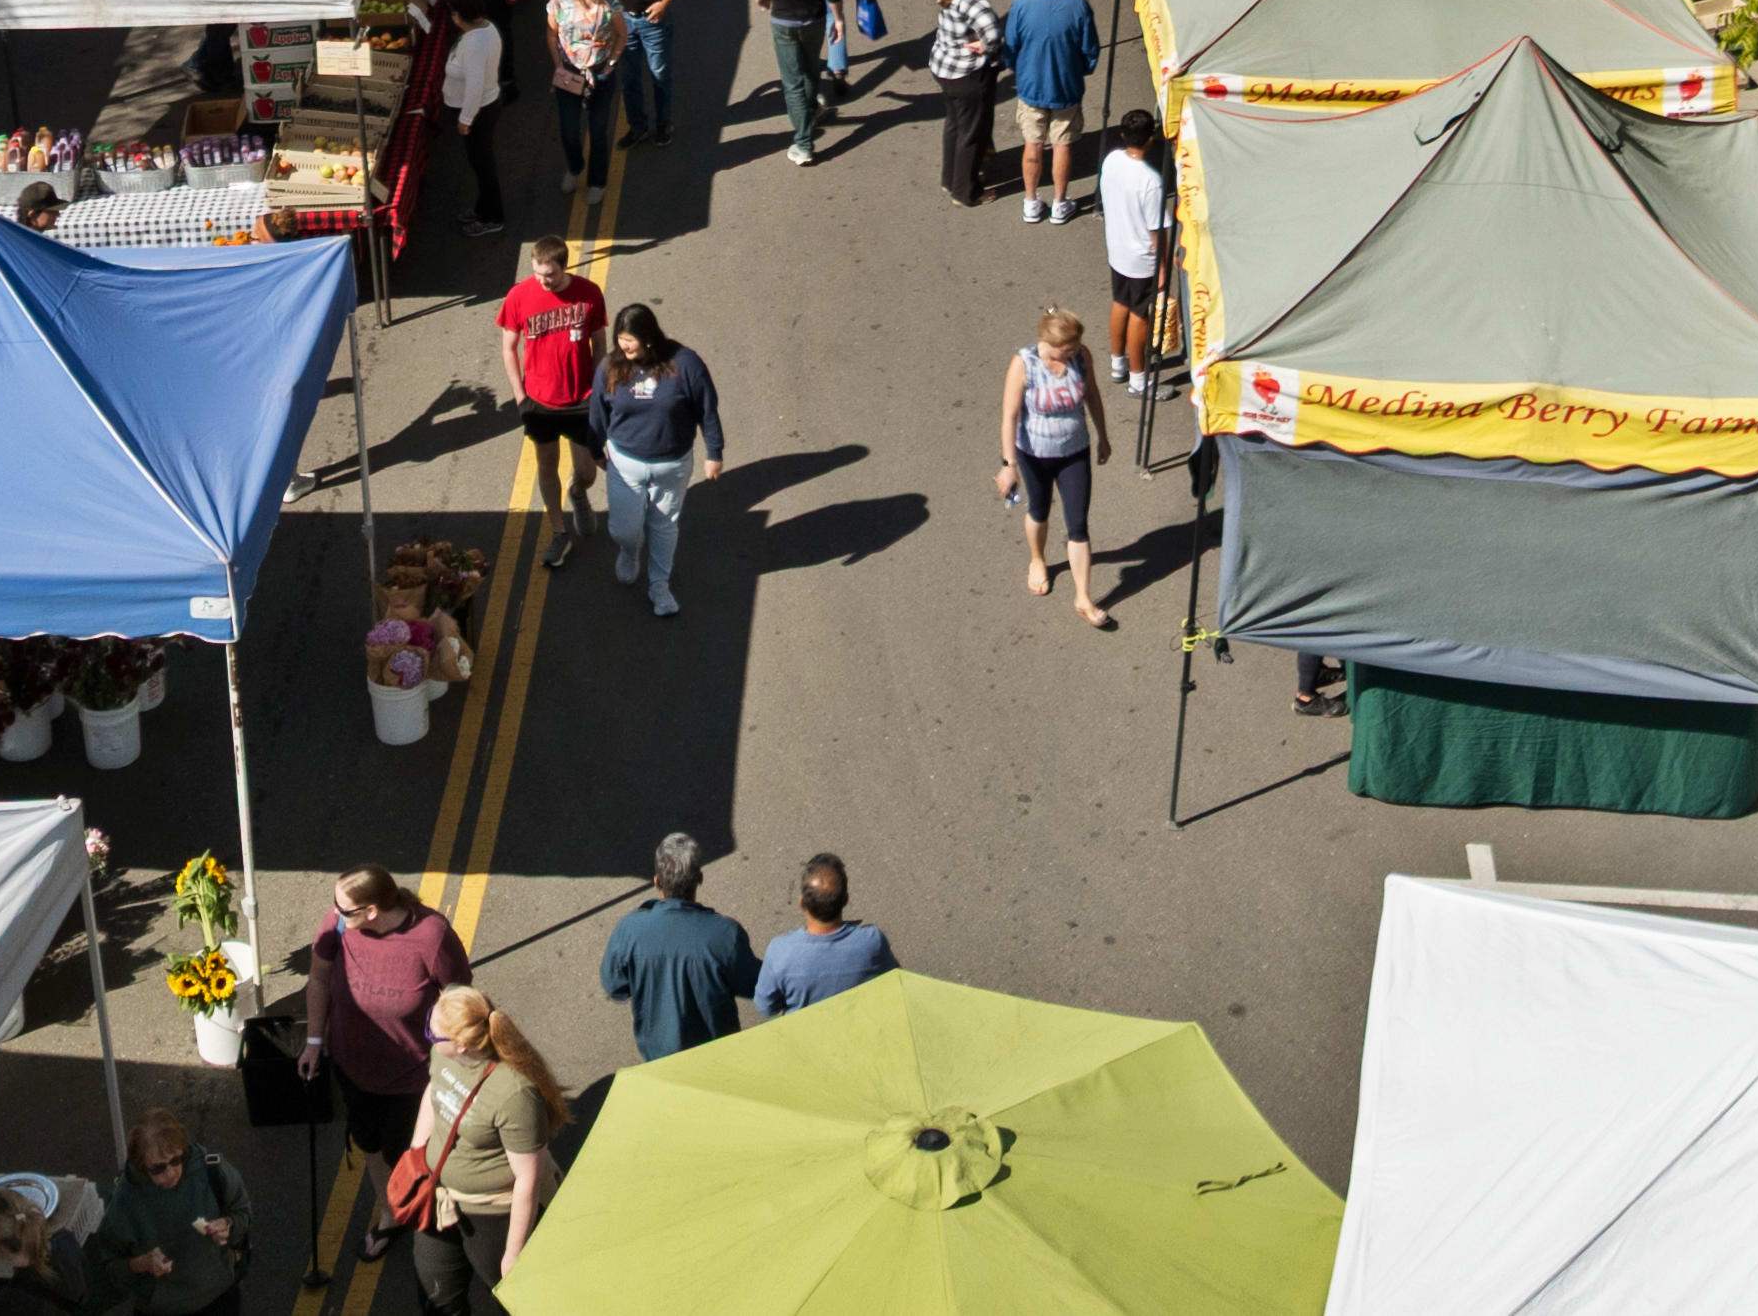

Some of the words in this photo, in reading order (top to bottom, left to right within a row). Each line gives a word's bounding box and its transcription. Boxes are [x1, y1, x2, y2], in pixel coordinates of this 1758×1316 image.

[1247, 82, 1401, 103] Medina
[528, 302, 593, 336] NEBRASKA
[1301, 383, 1483, 420] Medina
[1498, 393, 1629, 437] Berry
